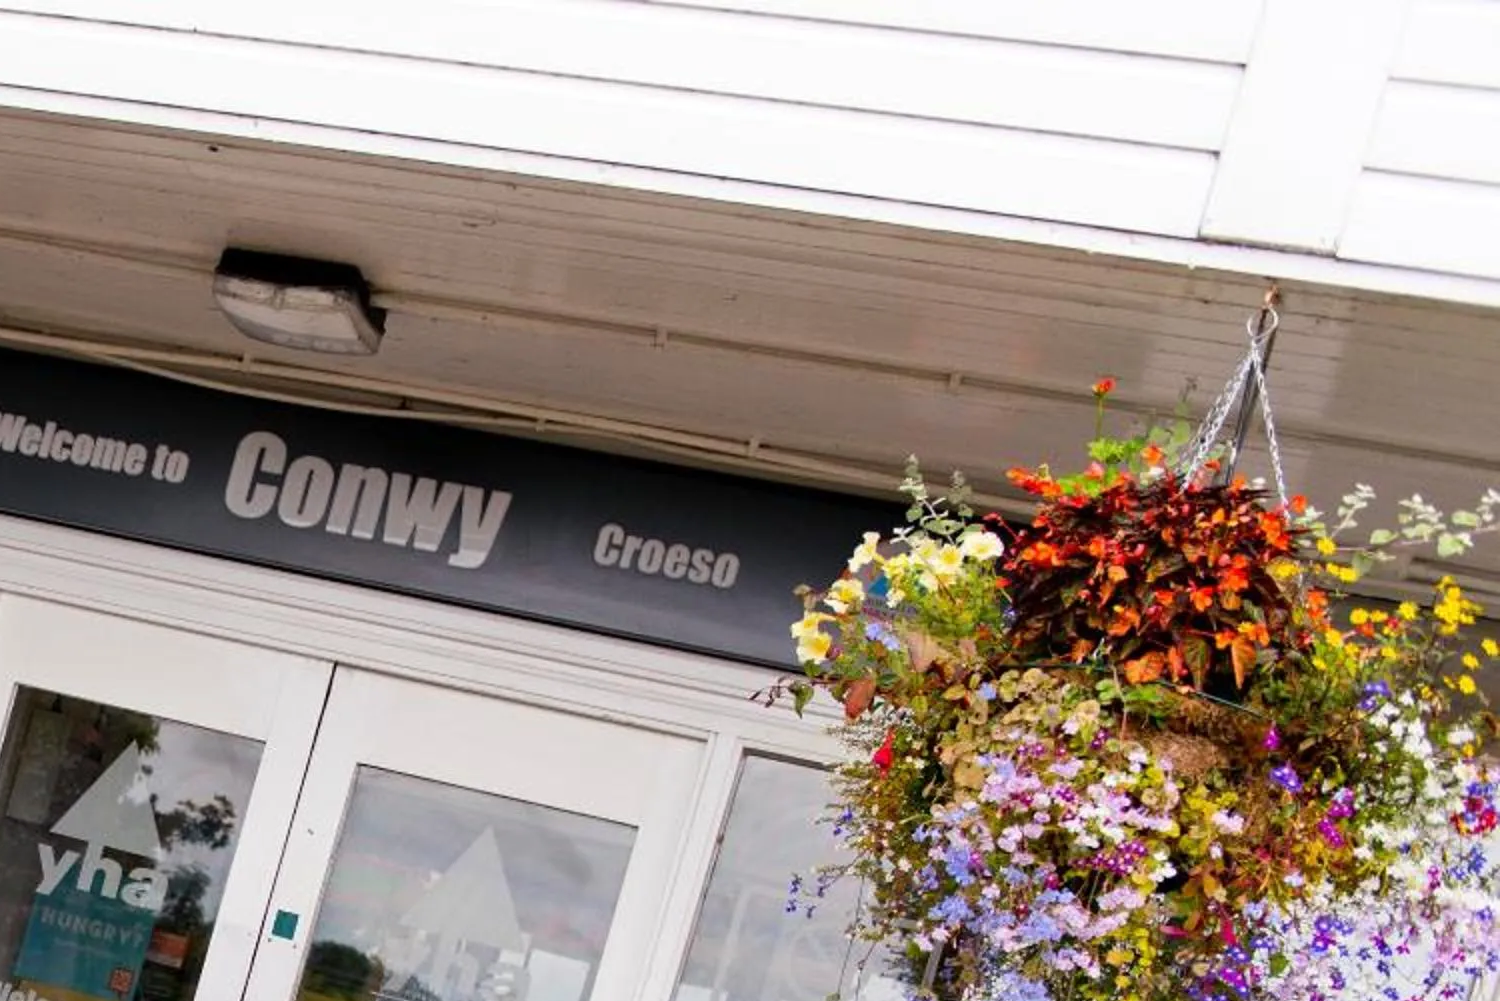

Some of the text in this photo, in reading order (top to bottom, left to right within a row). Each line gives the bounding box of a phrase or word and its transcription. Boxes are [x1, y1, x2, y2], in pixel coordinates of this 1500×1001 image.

[151, 444, 190, 484] to
[225, 431, 513, 570] Conwy
[593, 522, 740, 588] Croeso
[36, 842, 169, 916] yha
